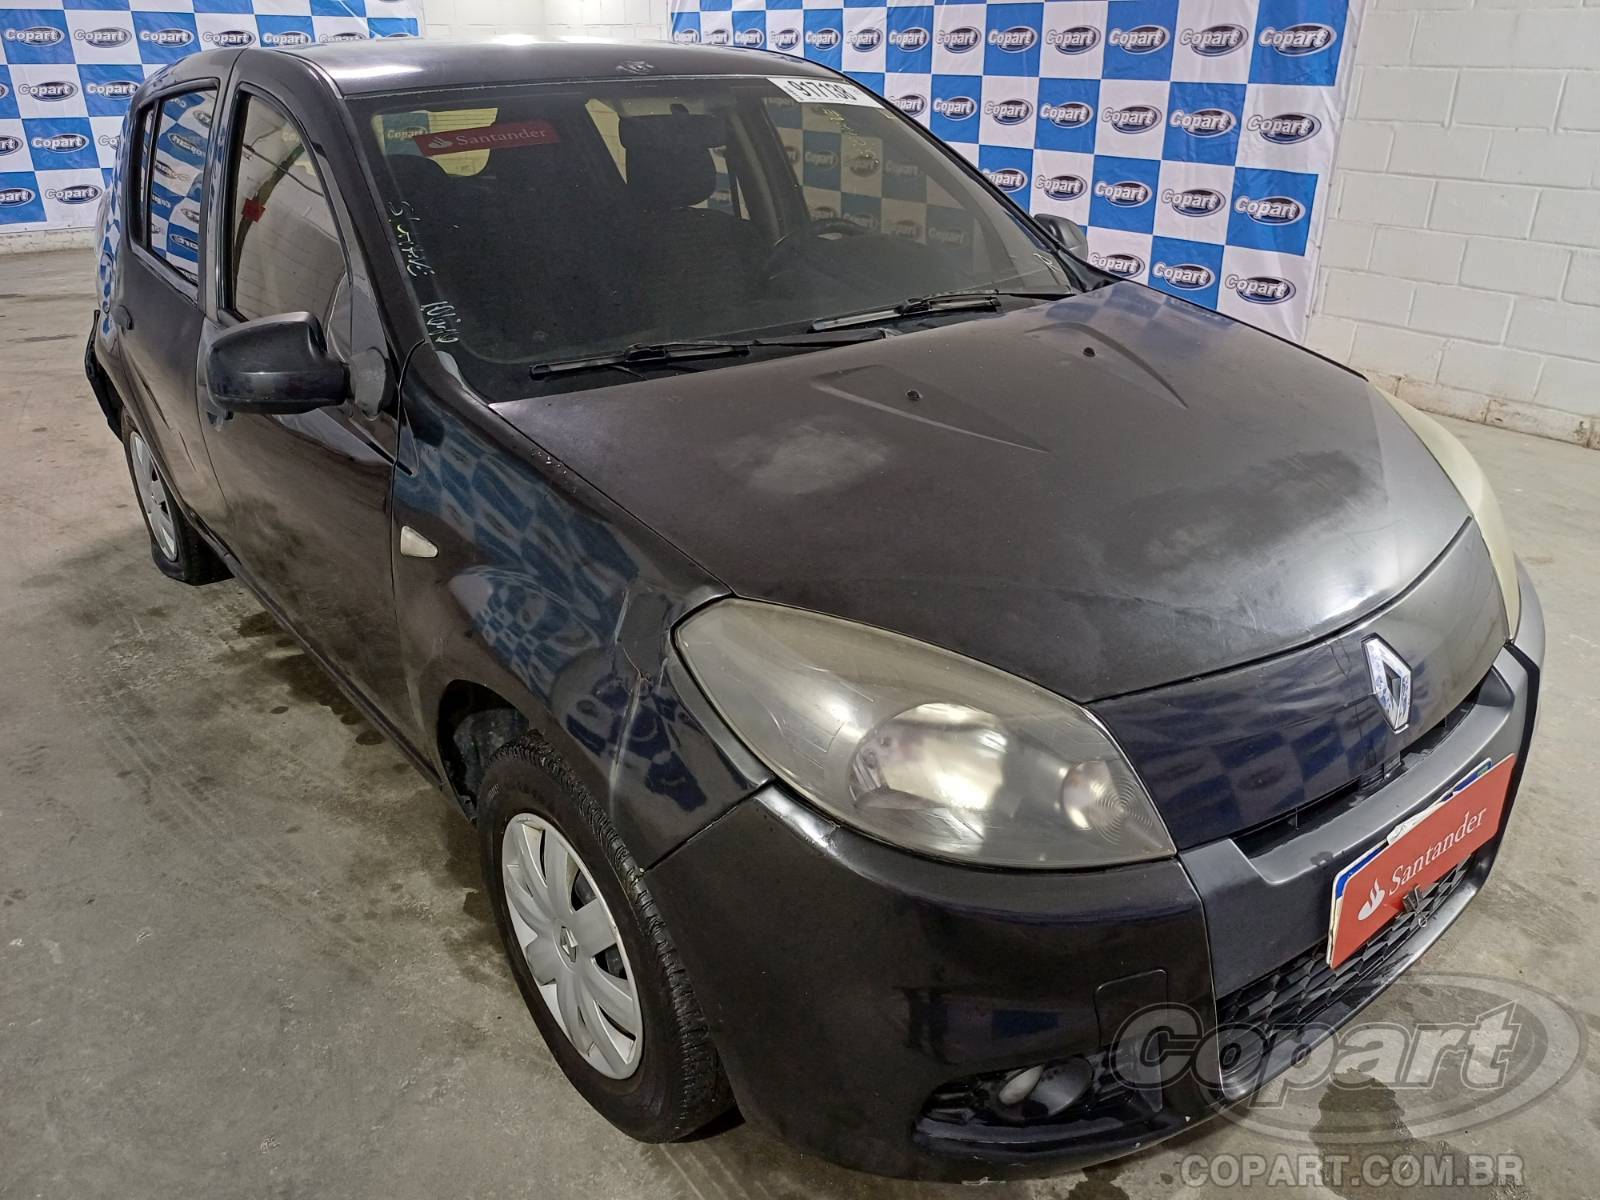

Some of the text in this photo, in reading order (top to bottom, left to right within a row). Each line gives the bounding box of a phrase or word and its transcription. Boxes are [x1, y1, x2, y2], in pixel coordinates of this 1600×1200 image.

[5, 28, 57, 44] Copart
[74, 29, 124, 44] Copart
[140, 31, 189, 45] Copart
[203, 32, 248, 46] Copart
[262, 33, 305, 45] Copart
[735, 31, 761, 46] Copart
[770, 31, 797, 46] Copart
[806, 31, 836, 47] Copart
[847, 31, 879, 47] Copart
[889, 28, 924, 47] Copart
[937, 28, 975, 47] Copart
[988, 28, 1031, 47] Copart
[1047, 29, 1094, 47] Copart
[1109, 28, 1163, 48] Copart
[1180, 28, 1238, 49] Copart
[1260, 28, 1328, 50] Copart
[19, 84, 72, 98] Copart
[87, 83, 135, 97] Copart
[934, 97, 971, 116] Copart
[984, 102, 1028, 121] Copart
[1040, 103, 1087, 123] Copart
[1102, 107, 1154, 128] Copart
[1169, 109, 1228, 134] Copart
[1246, 114, 1311, 140] Copart
[31, 137, 82, 150] Copart
[456, 127, 546, 146] Santander
[46, 188, 95, 201] Copart
[1036, 175, 1082, 196] Copart
[1094, 181, 1145, 203] Copart
[1161, 189, 1219, 213] Copart
[1234, 196, 1299, 221] Copart
[1088, 252, 1137, 275] Copart
[1152, 262, 1209, 285] Copart
[1225, 274, 1290, 301] Copart
[1389, 807, 1487, 897] Santander
